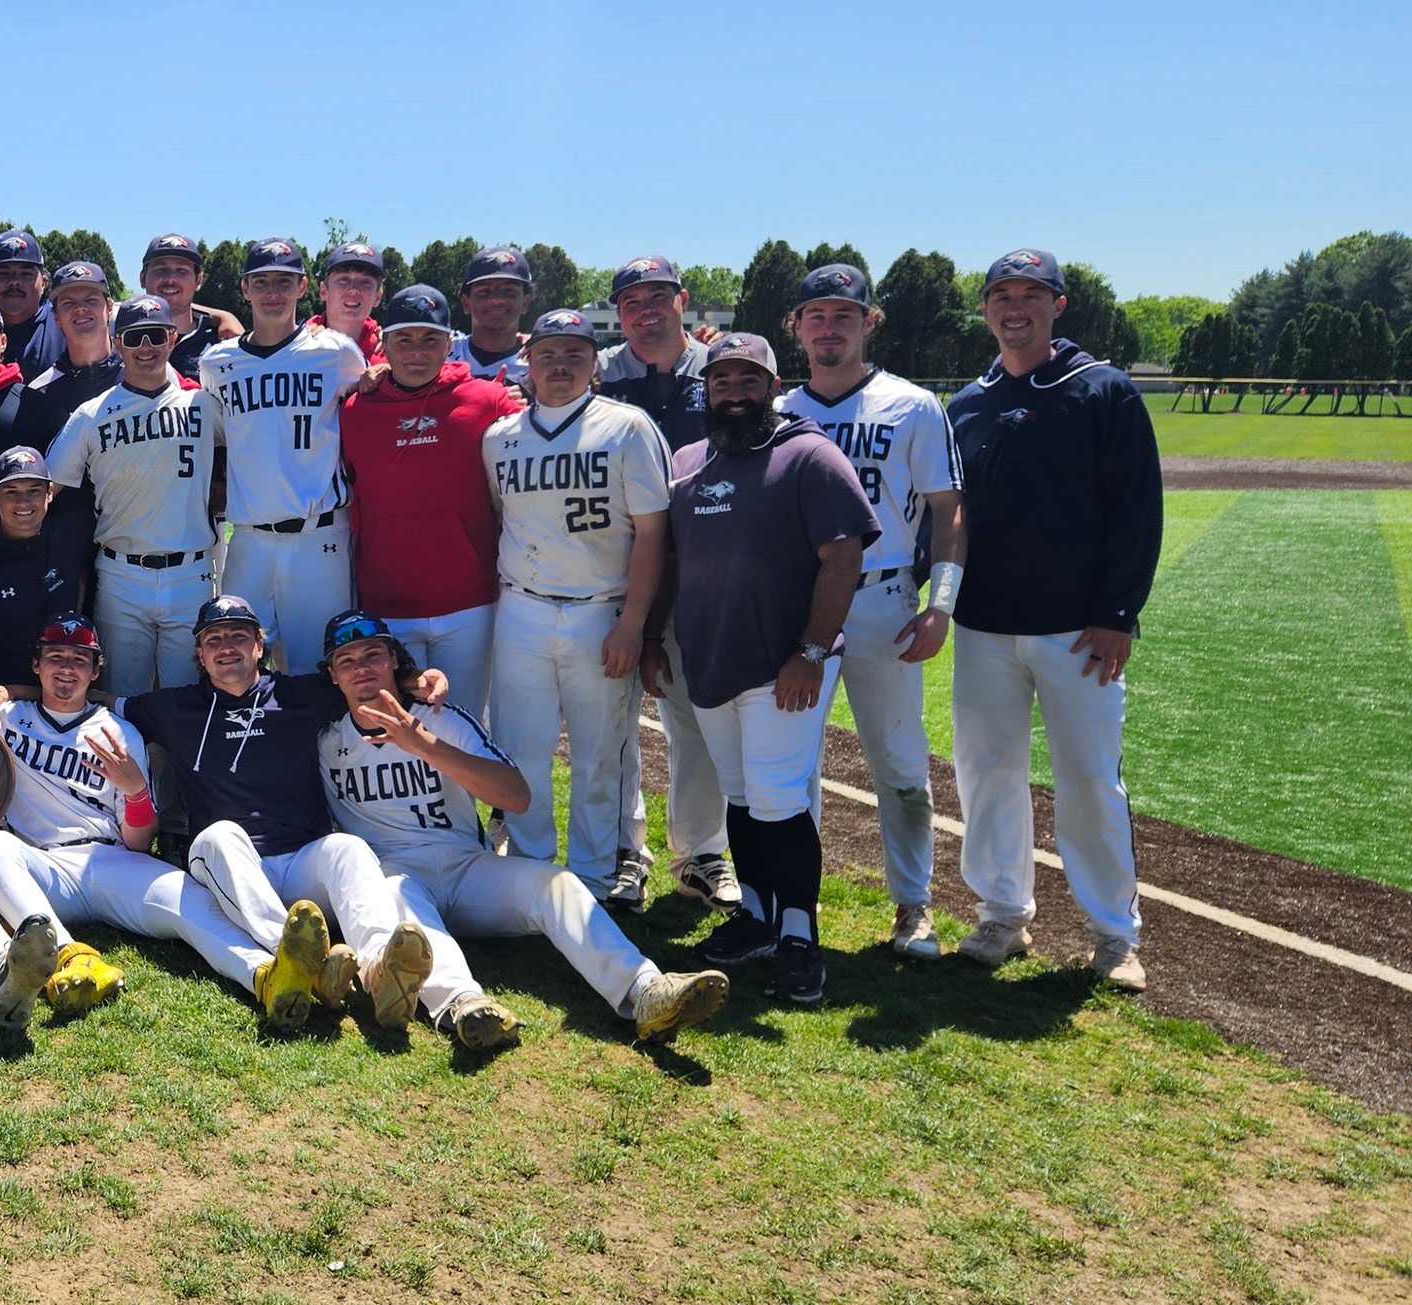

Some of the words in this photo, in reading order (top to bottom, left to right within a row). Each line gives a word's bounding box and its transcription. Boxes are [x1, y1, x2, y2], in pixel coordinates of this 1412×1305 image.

[218, 373, 323, 418] FALCONS
[98, 406, 202, 453] FALCONS
[293, 414, 312, 450] 11
[178, 445, 194, 478] 5
[495, 451, 608, 495] FALCONS
[854, 466, 882, 505] 8
[564, 496, 611, 533] 25
[694, 503, 732, 515] BASEBALL
[329, 759, 442, 803] FALCONS
[410, 798, 453, 829] 15
